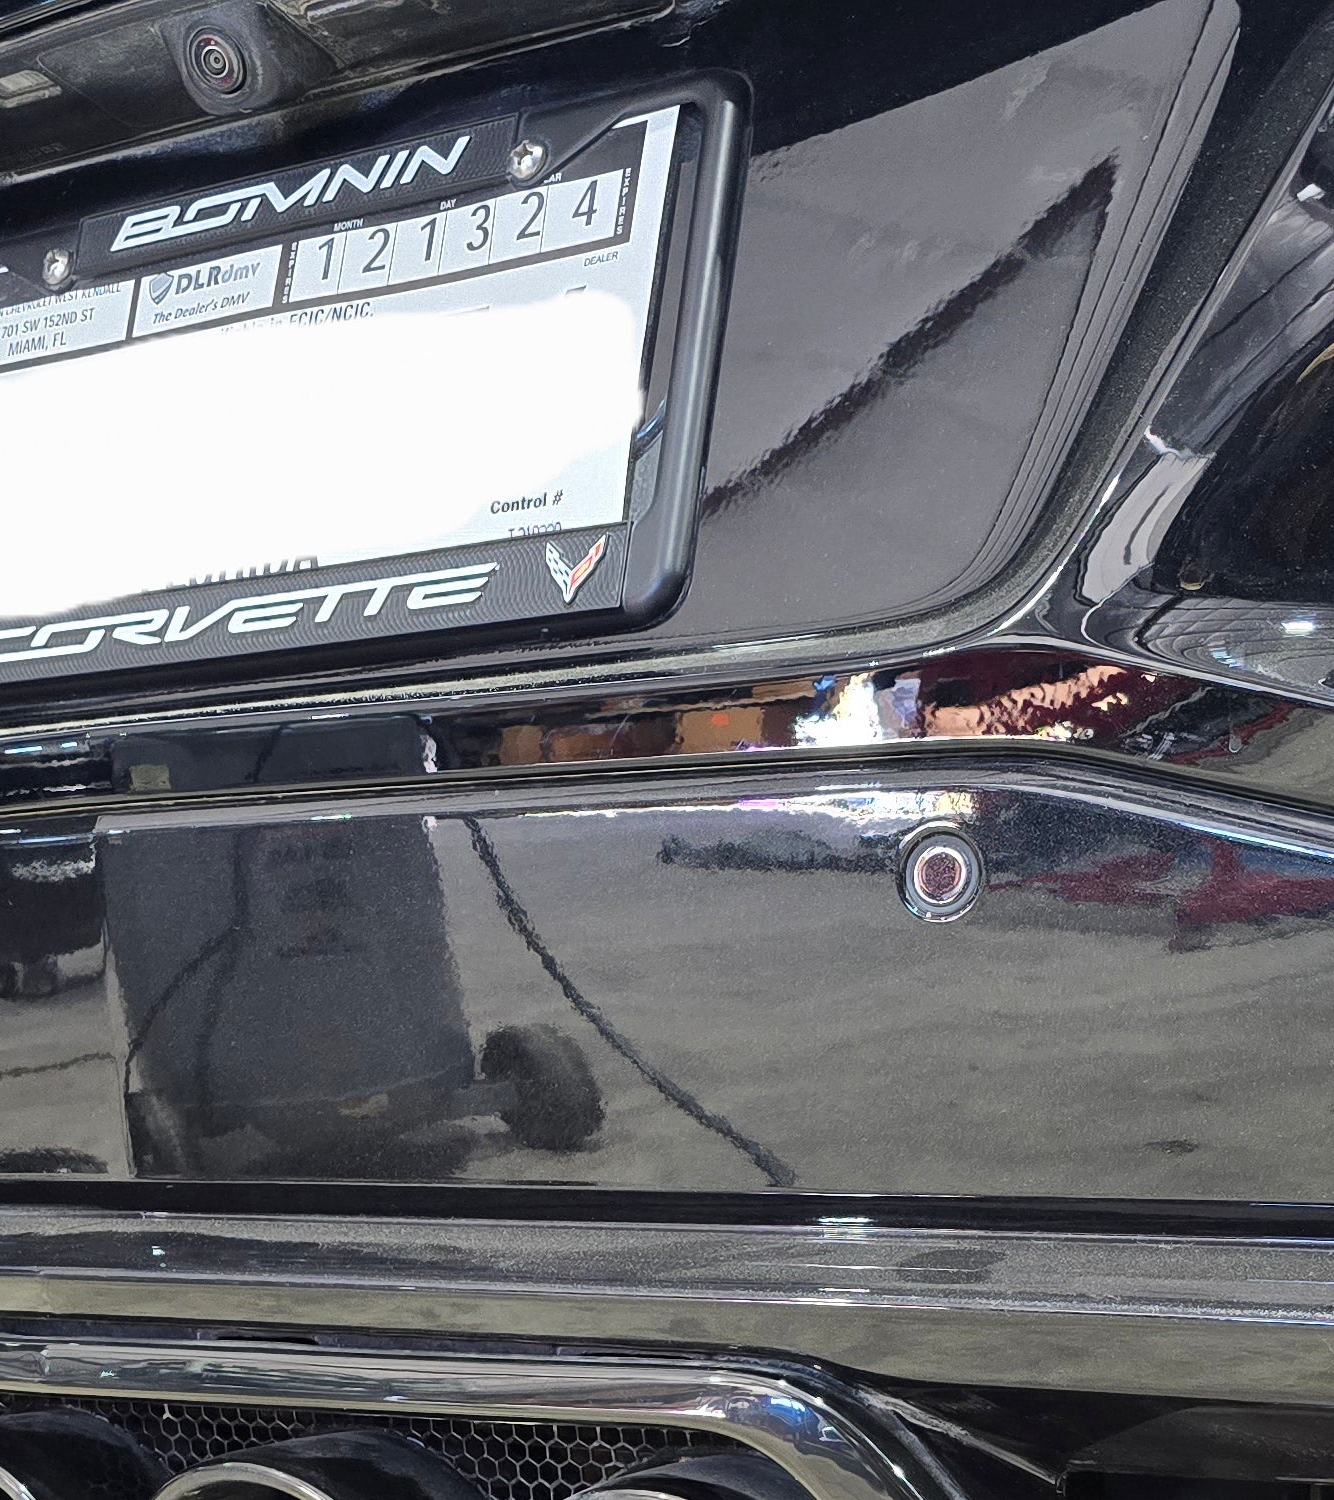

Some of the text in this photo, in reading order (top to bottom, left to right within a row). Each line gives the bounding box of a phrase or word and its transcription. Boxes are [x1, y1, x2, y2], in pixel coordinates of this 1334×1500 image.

[110, 135, 471, 252] BOMNIN
[439, 198, 457, 211] DAY
[616, 167, 632, 235] EXPIRES
[333, 218, 364, 232] MONTH
[583, 250, 619, 267] DEALER
[174, 261, 261, 296] DLRdmv
[21, 318, 41, 334] SW
[43, 312, 78, 329] 152ND
[80, 307, 96, 323] ST
[152, 291, 251, 325] The Dealer's DMV
[7, 332, 67, 357] MIAMI, FL
[490, 488, 564, 515] Control #
